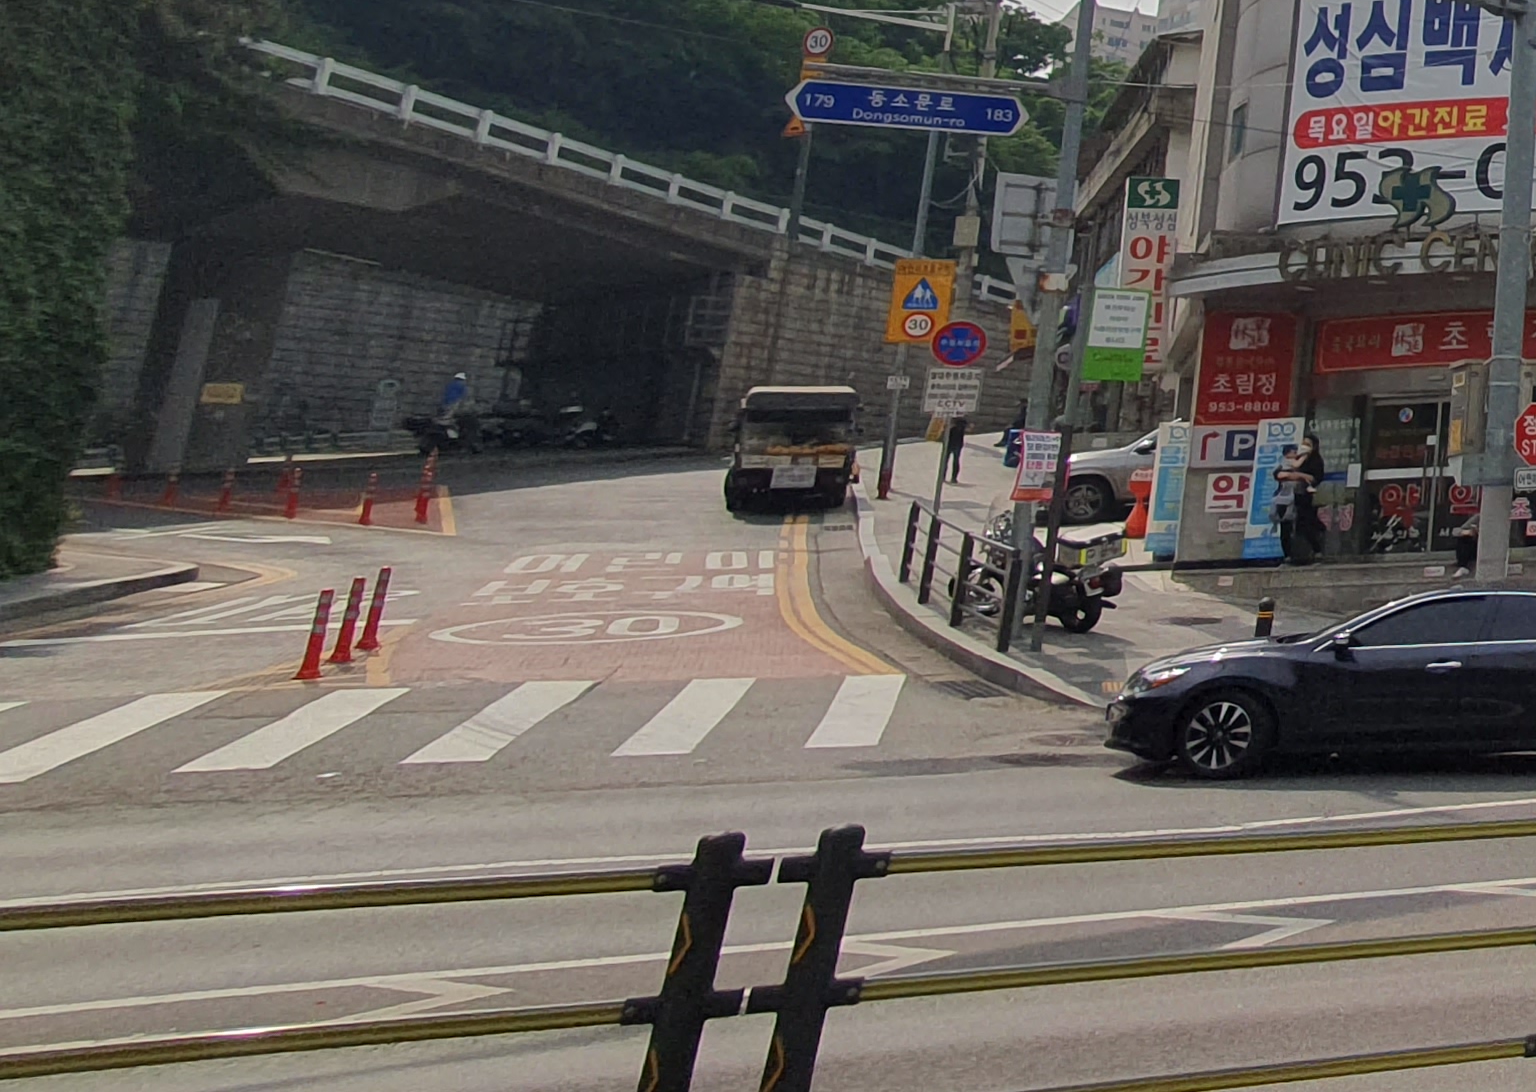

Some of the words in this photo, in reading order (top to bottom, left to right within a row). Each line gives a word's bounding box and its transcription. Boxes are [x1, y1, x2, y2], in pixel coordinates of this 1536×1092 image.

[809, 35, 828, 49] 30
[804, 92, 835, 109] 179
[867, 89, 956, 112] 동소문로
[852, 109, 966, 128] Dongsomun-ro
[985, 108, 1013, 122] 183
[1126, 210, 1178, 232] 성북성심
[1279, 233, 1405, 282] CLINIC
[908, 319, 929, 331] 30
[1209, 372, 1278, 396] 초림정
[1231, 433, 1256, 458] P
[504, 550, 775, 575] 어린이
[459, 573, 775, 606] 보호구역
[501, 615, 681, 639] 30
